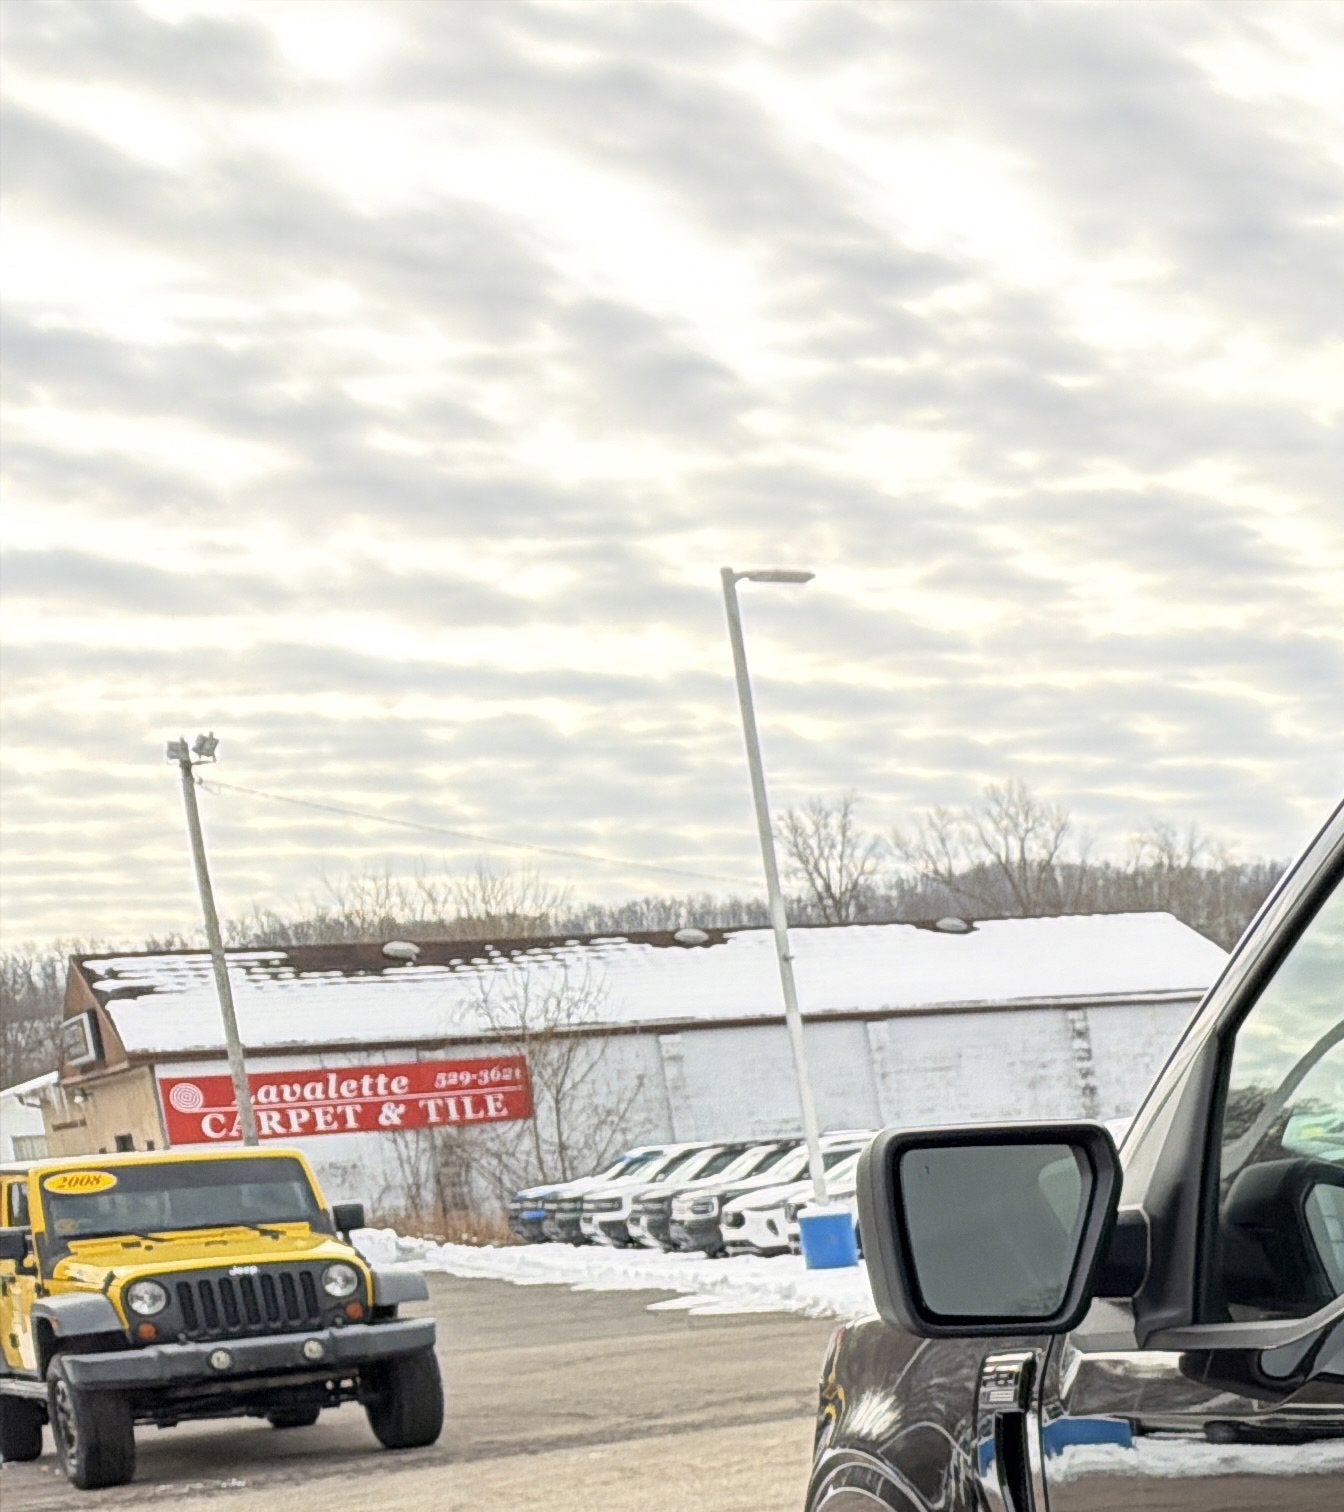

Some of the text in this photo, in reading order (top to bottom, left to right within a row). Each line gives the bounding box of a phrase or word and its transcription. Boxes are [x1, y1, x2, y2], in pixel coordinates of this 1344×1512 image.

[379, 1102, 406, 1126] &
[419, 1093, 508, 1123] TILE
[56, 1174, 101, 1189] 2008
